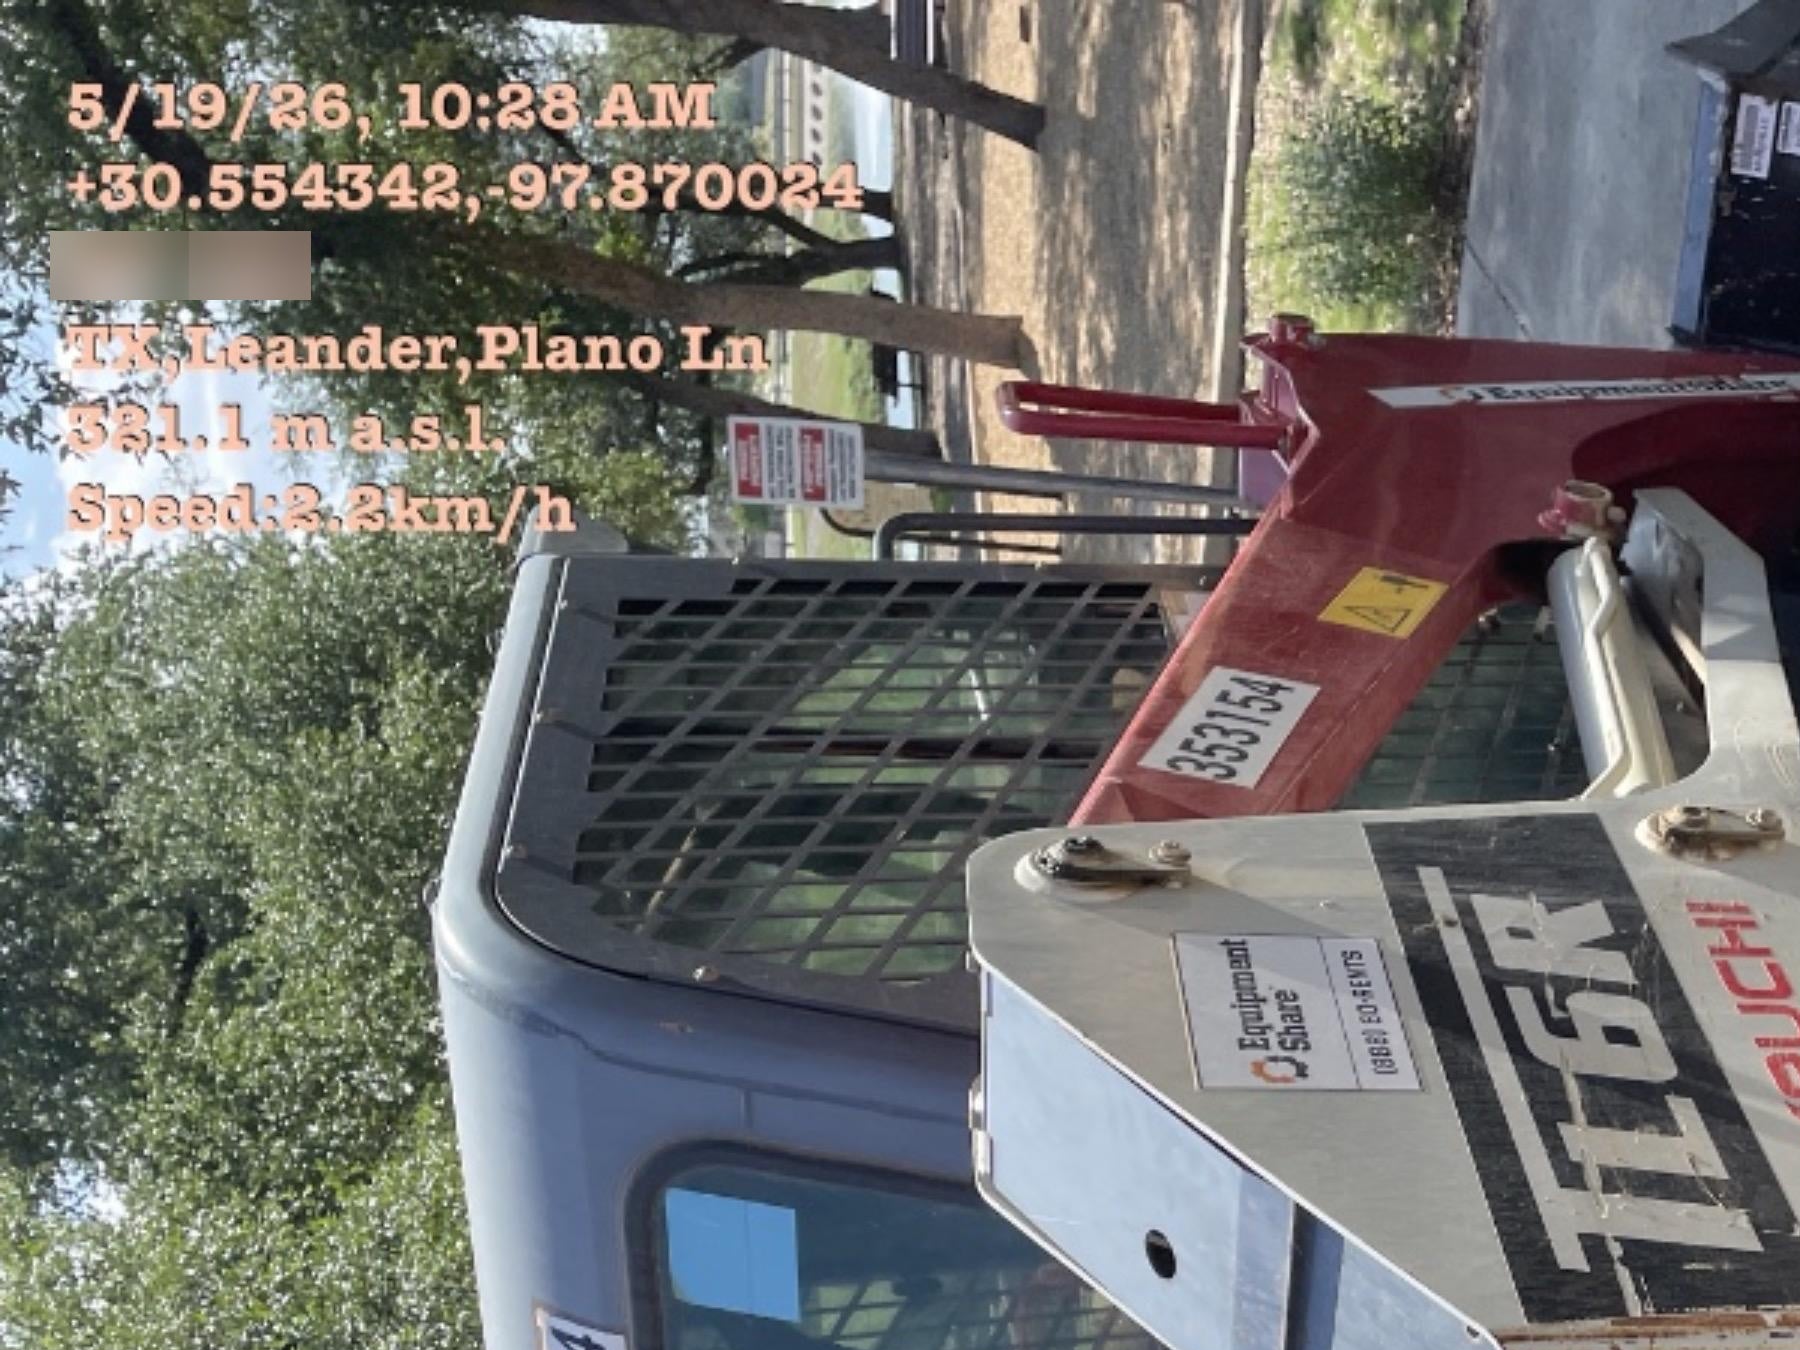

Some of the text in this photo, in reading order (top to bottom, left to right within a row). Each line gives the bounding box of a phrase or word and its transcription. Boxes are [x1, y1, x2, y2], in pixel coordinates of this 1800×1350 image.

[1165, 676, 1296, 780] 353154
[1218, 938, 1274, 1052] Equipment
[1270, 987, 1313, 1052] Share
[1416, 865, 1765, 1274] TL6R
